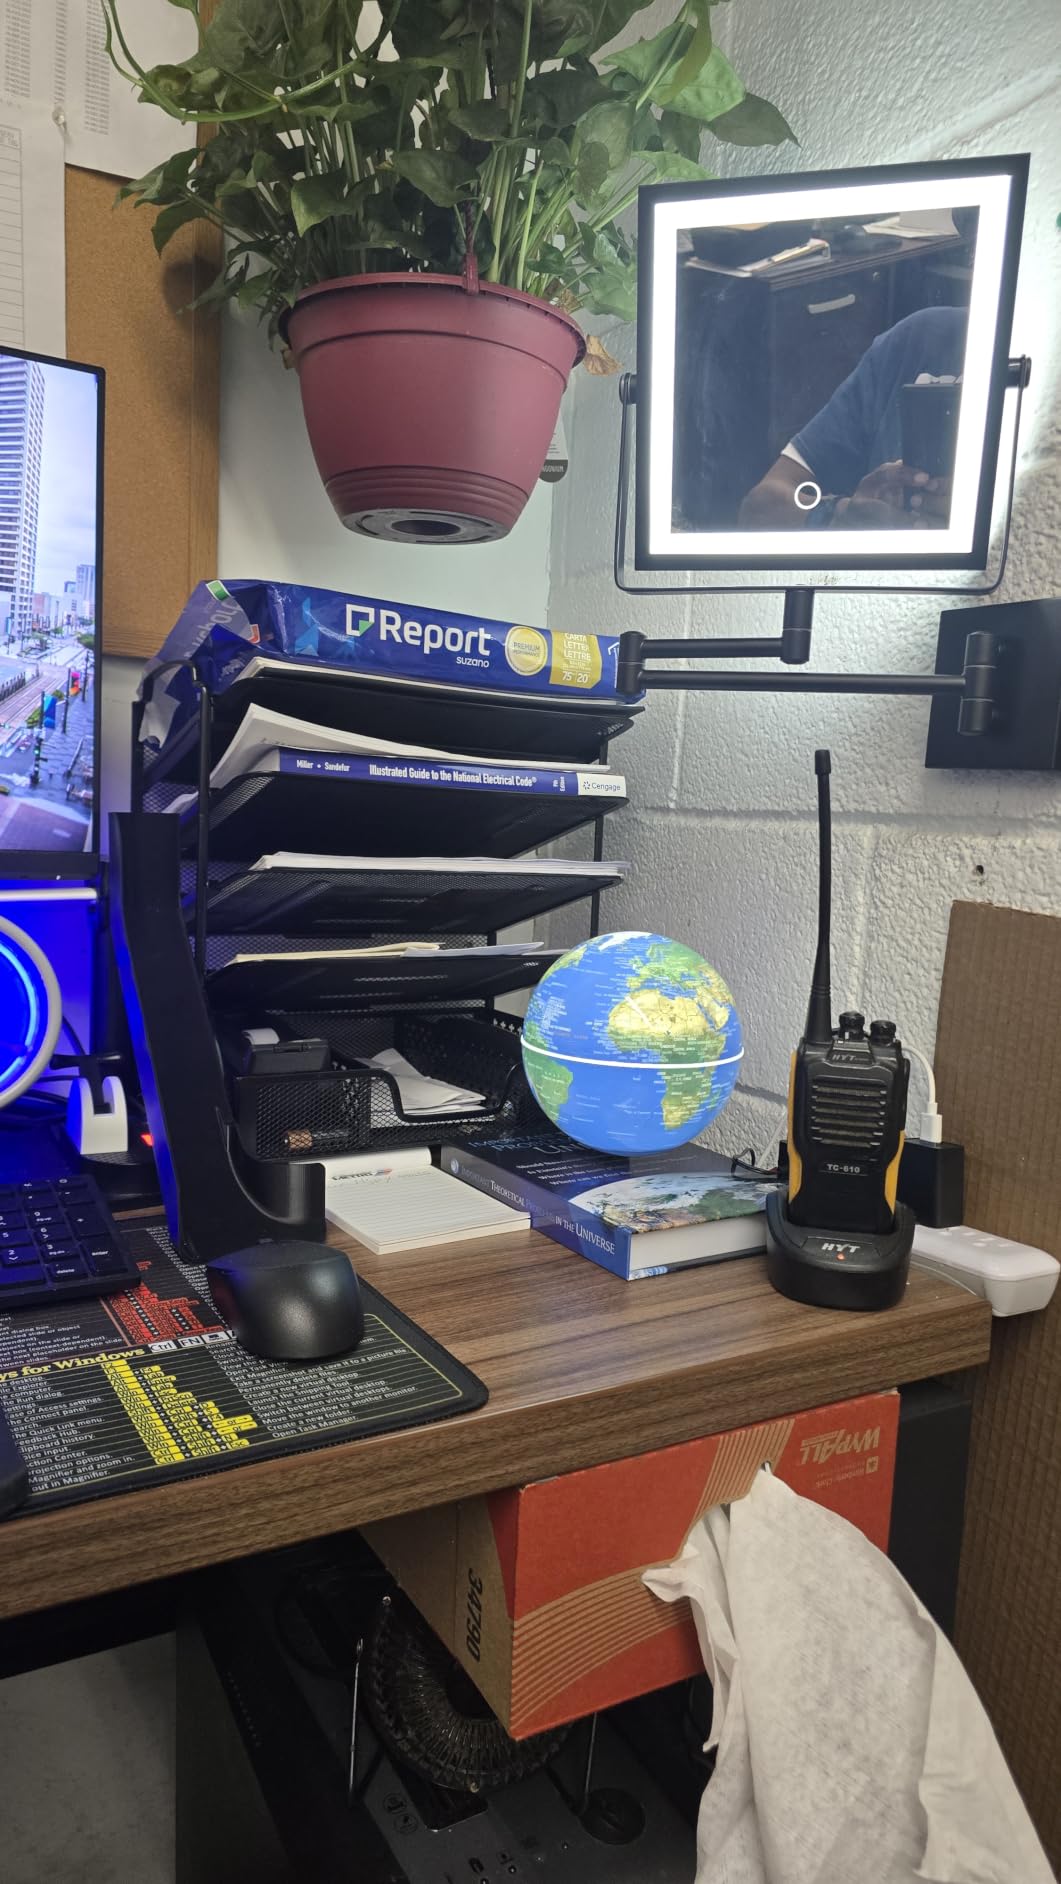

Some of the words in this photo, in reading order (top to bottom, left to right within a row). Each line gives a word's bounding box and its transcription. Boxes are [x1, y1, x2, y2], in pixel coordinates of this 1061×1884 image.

[379, 609, 491, 657] Report
[513, 641, 541, 651] PREMIUM
[564, 641, 590, 651] LETTER
[564, 650, 591, 660] LETTRE
[456, 656, 490, 668] suzano
[296, 759, 314, 769] Miller
[324, 762, 350, 772] Sandefur
[369, 764, 407, 778] Illustrated
[409, 767, 430, 780] Guide
[431, 769, 439, 780] to
[440, 769, 452, 781] the
[453, 771, 482, 784] National
[482, 774, 514, 786] Electrical
[591, 781, 621, 792] Cengage
[832, 1054, 856, 1062] HYT
[827, 1163, 861, 1174] TC-610
[563, 1219, 575, 1233] THE
[575, 1223, 615, 1255] UNIVERSE
[821, 1242, 861, 1254] HYT
[151, 1342, 172, 1351] Ctrl
[181, 1338, 200, 1346] FN
[213, 1352, 235, 1360] Close
[217, 1357, 244, 1365] Switch
[22, 1365, 51, 1376] for
[52, 1349, 145, 1370] Windows
[221, 1363, 242, 1371] View
[262, 1370, 306, 1382] screenshot
[367, 1351, 394, 1361] picture
[225, 1367, 249, 1376] Open
[230, 1374, 246, 1382] Exit
[238, 1379, 291, 1393] Permanently
[293, 1374, 318, 1383] delete
[243, 1390, 271, 1399] Create
[280, 1384, 297, 1392] new
[299, 1378, 325, 1387] virtual
[248, 1395, 278, 1406] Launch
[295, 1383, 332, 1396] Snipping
[252, 1403, 276, 1412] Close
[294, 1393, 324, 1403] current
[326, 1387, 352, 1397] virtual
[262, 1416, 287, 1424] Move
[305, 1405, 338, 1416] window
[351, 1395, 383, 1407] another
[384, 1386, 418, 1399] monitor.
[39, 1403, 68, 1412] Access
[257, 1408, 286, 1418] Switch
[287, 1400, 324, 1413] between
[326, 1394, 353, 1404] virtual
[24, 1412, 61, 1422] Connect
[267, 1422, 296, 1431] Create
[305, 1415, 323, 1423] new
[325, 1409, 353, 1419] folder.
[30, 1426, 55, 1435] Quick
[57, 1422, 75, 1430] Link
[78, 1417, 105, 1426] menu.
[272, 1429, 297, 1438] Open
[297, 1424, 318, 1433] Task
[318, 1415, 359, 1428] Manager.
[60, 1429, 81, 1438] Hub.
[62, 1433, 96, 1445] history.
[44, 1446, 71, 1456] input.
[55, 1451, 88, 1462] Center.
[76, 1454, 113, 1466] options.
[77, 1465, 94, 1473] and
[97, 1459, 121, 1469] zoom
[123, 1455, 136, 1463] in.
[32, 1482, 49, 1492] out
[51, 1480, 60, 1488] in
[63, 1470, 111, 1485] Magnifier.
[466, 1567, 482, 1663] 34790
